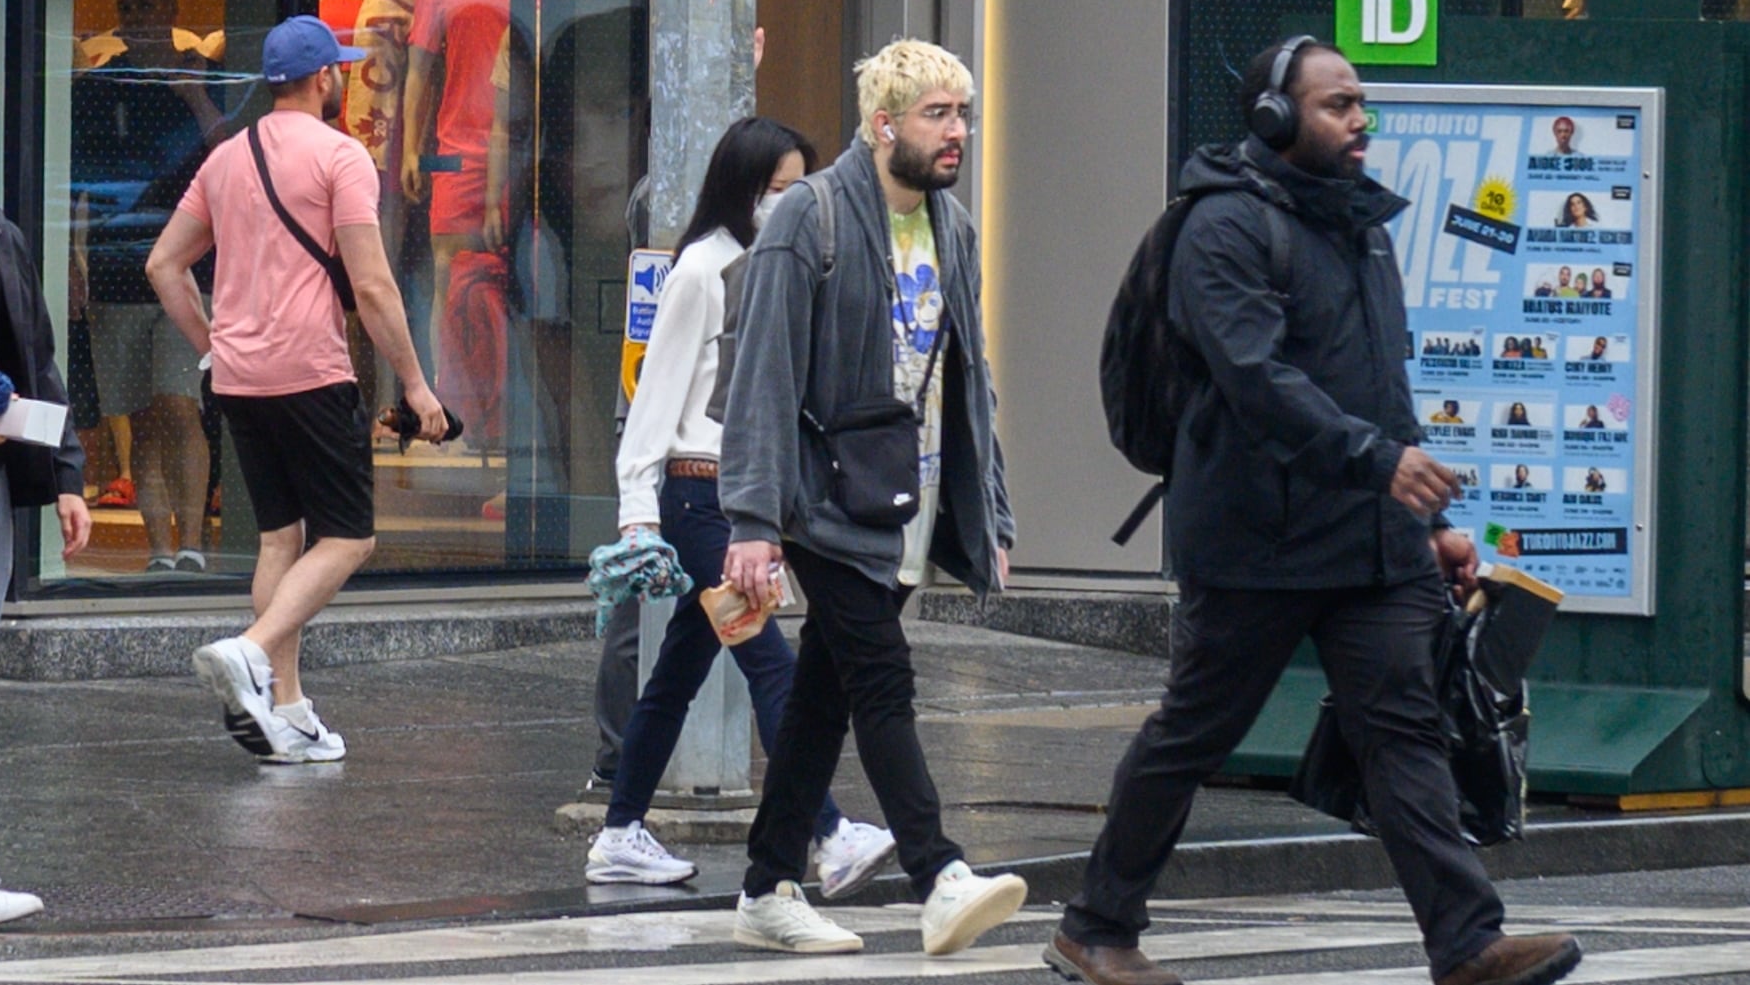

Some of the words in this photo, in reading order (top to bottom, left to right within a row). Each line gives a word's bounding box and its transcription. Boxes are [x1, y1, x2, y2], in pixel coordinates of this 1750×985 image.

[1385, 113, 1479, 135] TORONTO
[1486, 190, 1505, 206] 10
[1364, 115, 1522, 308] AZZ
[1451, 214, 1482, 233] JUNE
[1429, 287, 1498, 310] FEST
